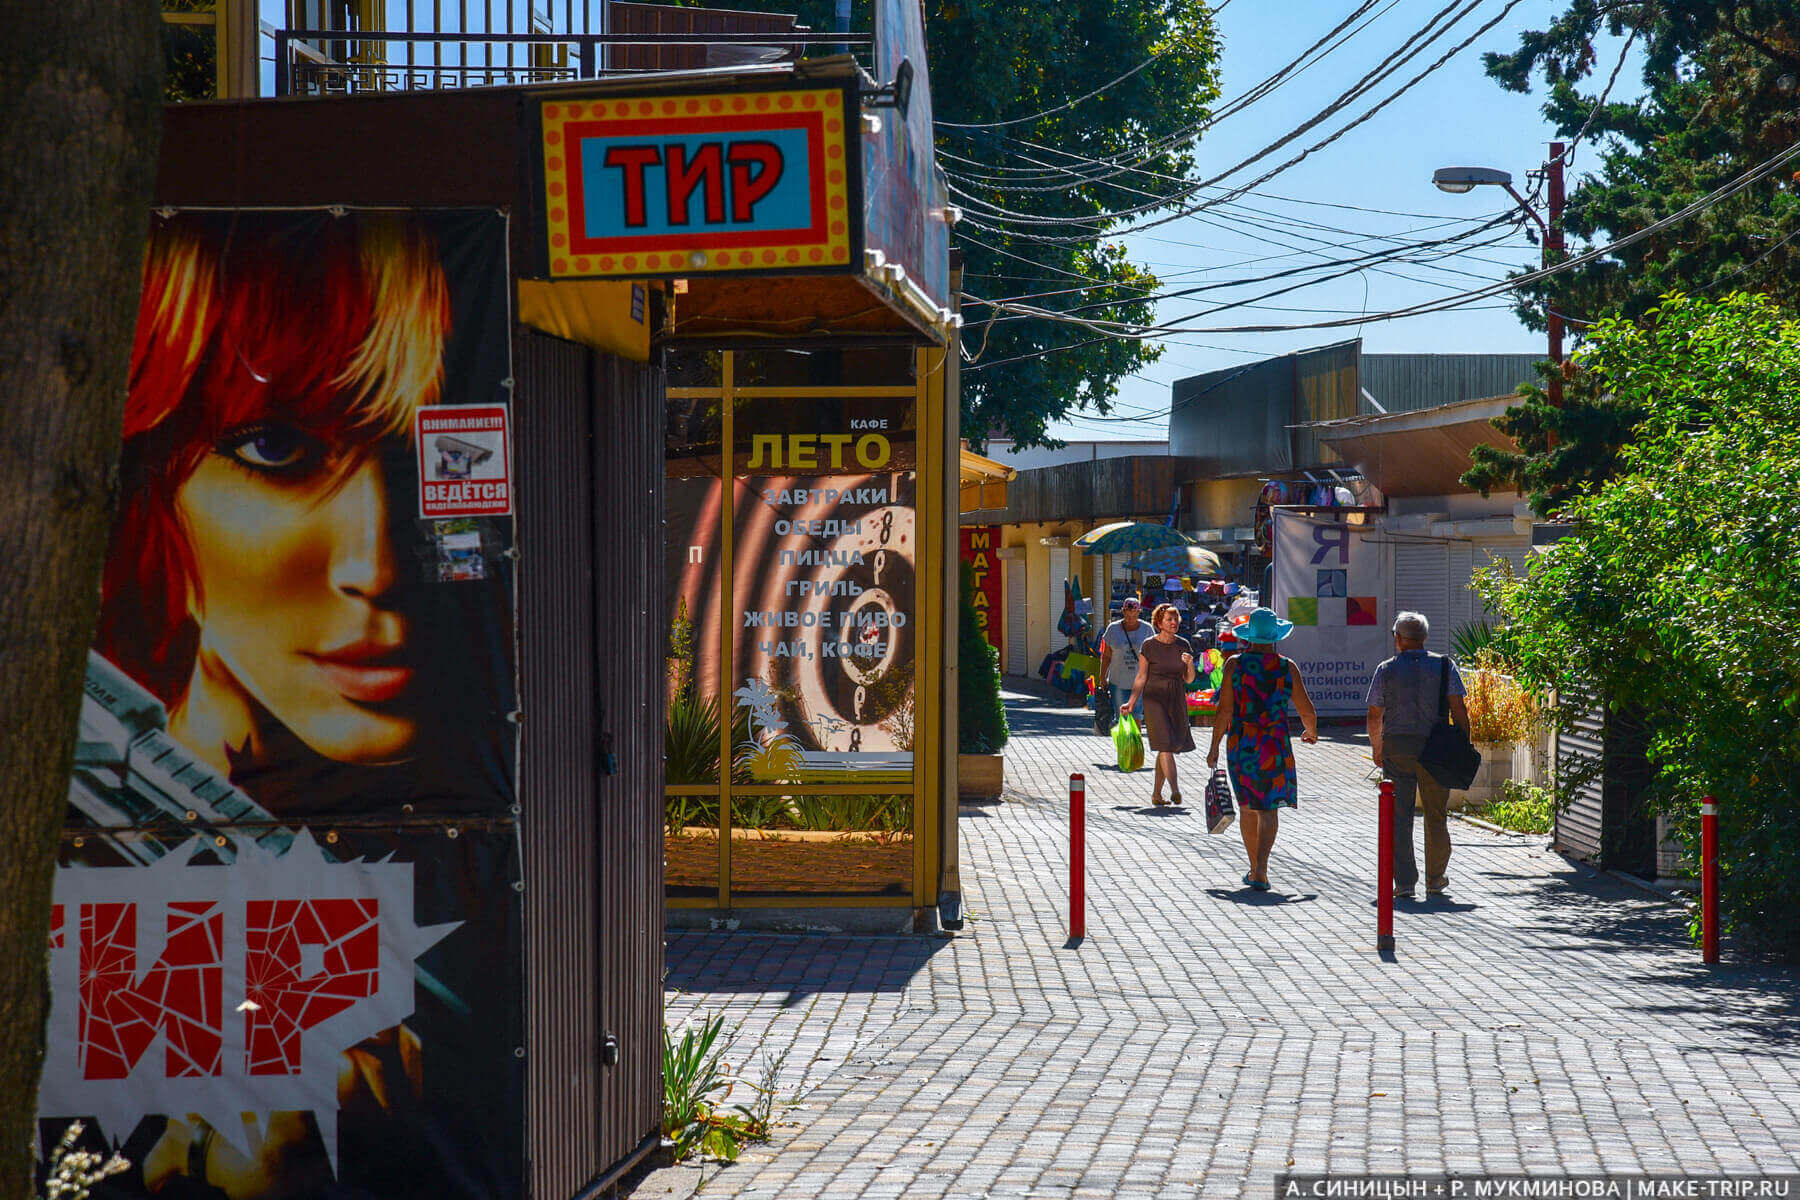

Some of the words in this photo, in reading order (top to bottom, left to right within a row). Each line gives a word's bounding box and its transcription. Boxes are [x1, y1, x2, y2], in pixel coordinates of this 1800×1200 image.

[603, 140, 784, 228] ТИР
[850, 419, 889, 430] КАФЕ
[747, 433, 892, 469] ЛЕТО
[424, 481, 508, 503] ВЕДЁТСЯ
[763, 488, 888, 505] ЗАВТРАКИ
[774, 519, 863, 539] ОБЕДЫ
[1310, 523, 1351, 565] Я
[779, 550, 865, 569] ПИЦЦА
[786, 580, 864, 597] ГРИЛЬ
[970, 532, 990, 647] МАГАЗ
[744, 611, 832, 628] ЖИВОЕ
[840, 611, 907, 628] ПИВО
[758, 637, 815, 660] ЧАЙ,
[822, 641, 888, 659] КОФЕ
[1300, 661, 1366, 673] курорты
[50, 898, 380, 1081] ИР
